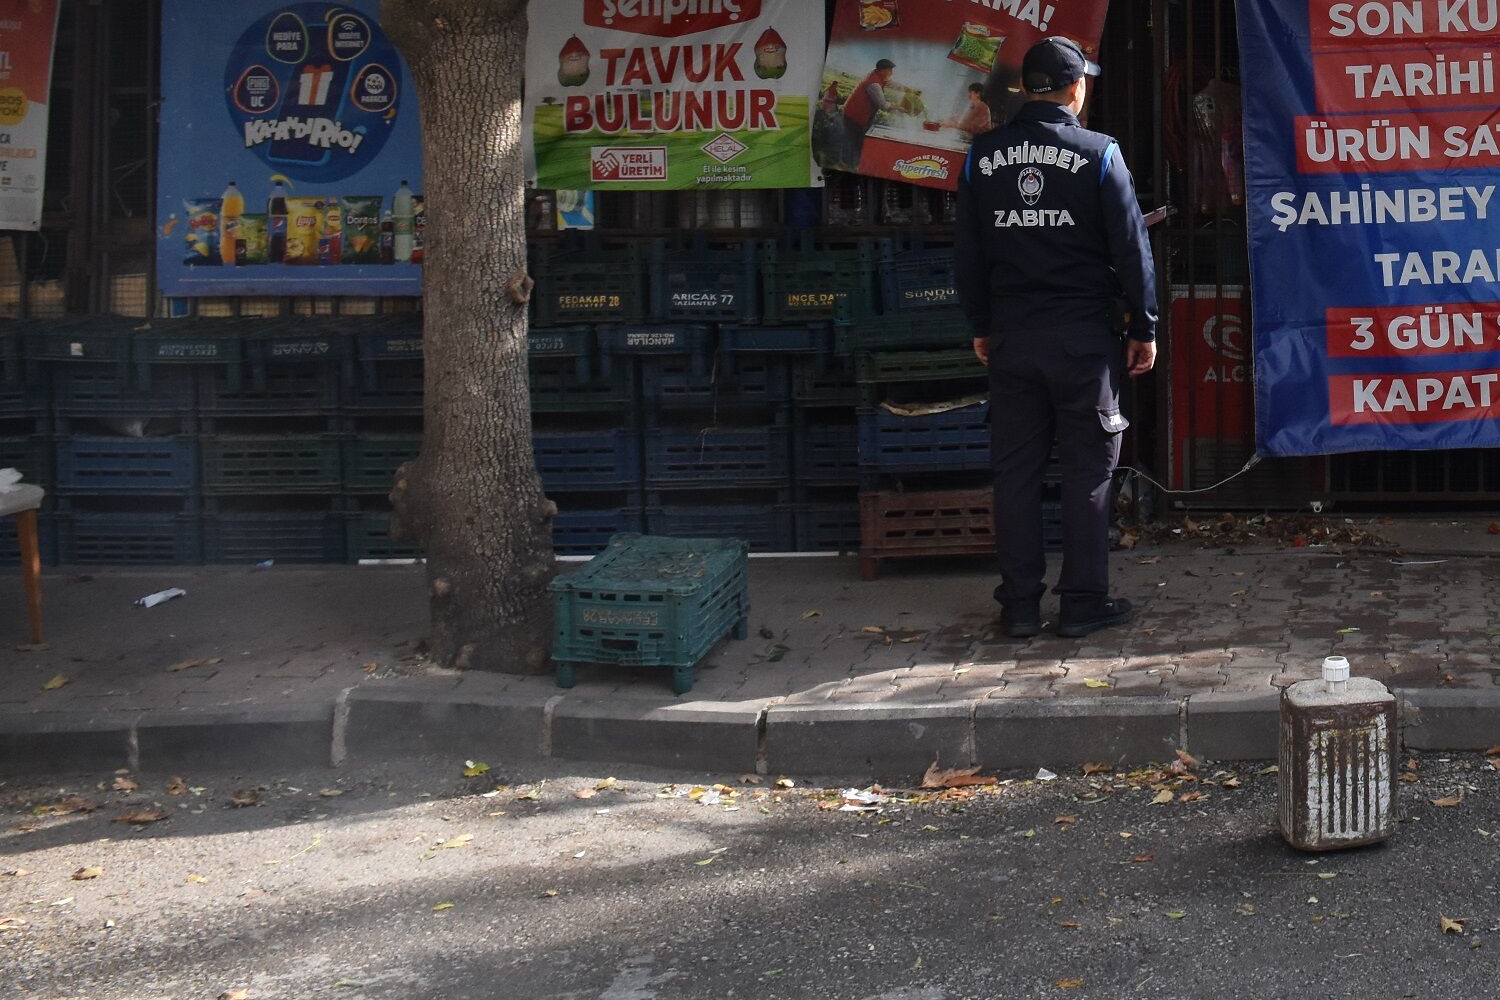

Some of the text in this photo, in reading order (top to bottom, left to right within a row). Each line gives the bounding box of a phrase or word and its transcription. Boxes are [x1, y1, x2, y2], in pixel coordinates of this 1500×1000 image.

[1328, 1, 1430, 37] SON
[276, 42, 298, 51] PARA
[600, 43, 744, 85] TAVUK
[1346, 52, 1494, 99] TARİHİ
[250, 96, 265, 108] UC
[566, 89, 777, 132] BULUNUR
[1305, 121, 1430, 163] ÜRÜN
[622, 152, 653, 164] YERLİ
[979, 140, 1089, 176] ŞAHİNBEY
[621, 161, 663, 176] ÜRETİM
[723, 164, 747, 173] kesim
[1270, 183, 1495, 232] ŞAHİNBEY
[347, 215, 378, 225] Doritos
[994, 209, 1075, 228] ZABITA
[559, 296, 620, 308] FEDAKAR 28
[672, 293, 734, 306] ARICAK 77
[1350, 318, 1375, 350] 3
[1388, 307, 1483, 348] GÜN
[627, 337, 674, 345] HANCILAR
